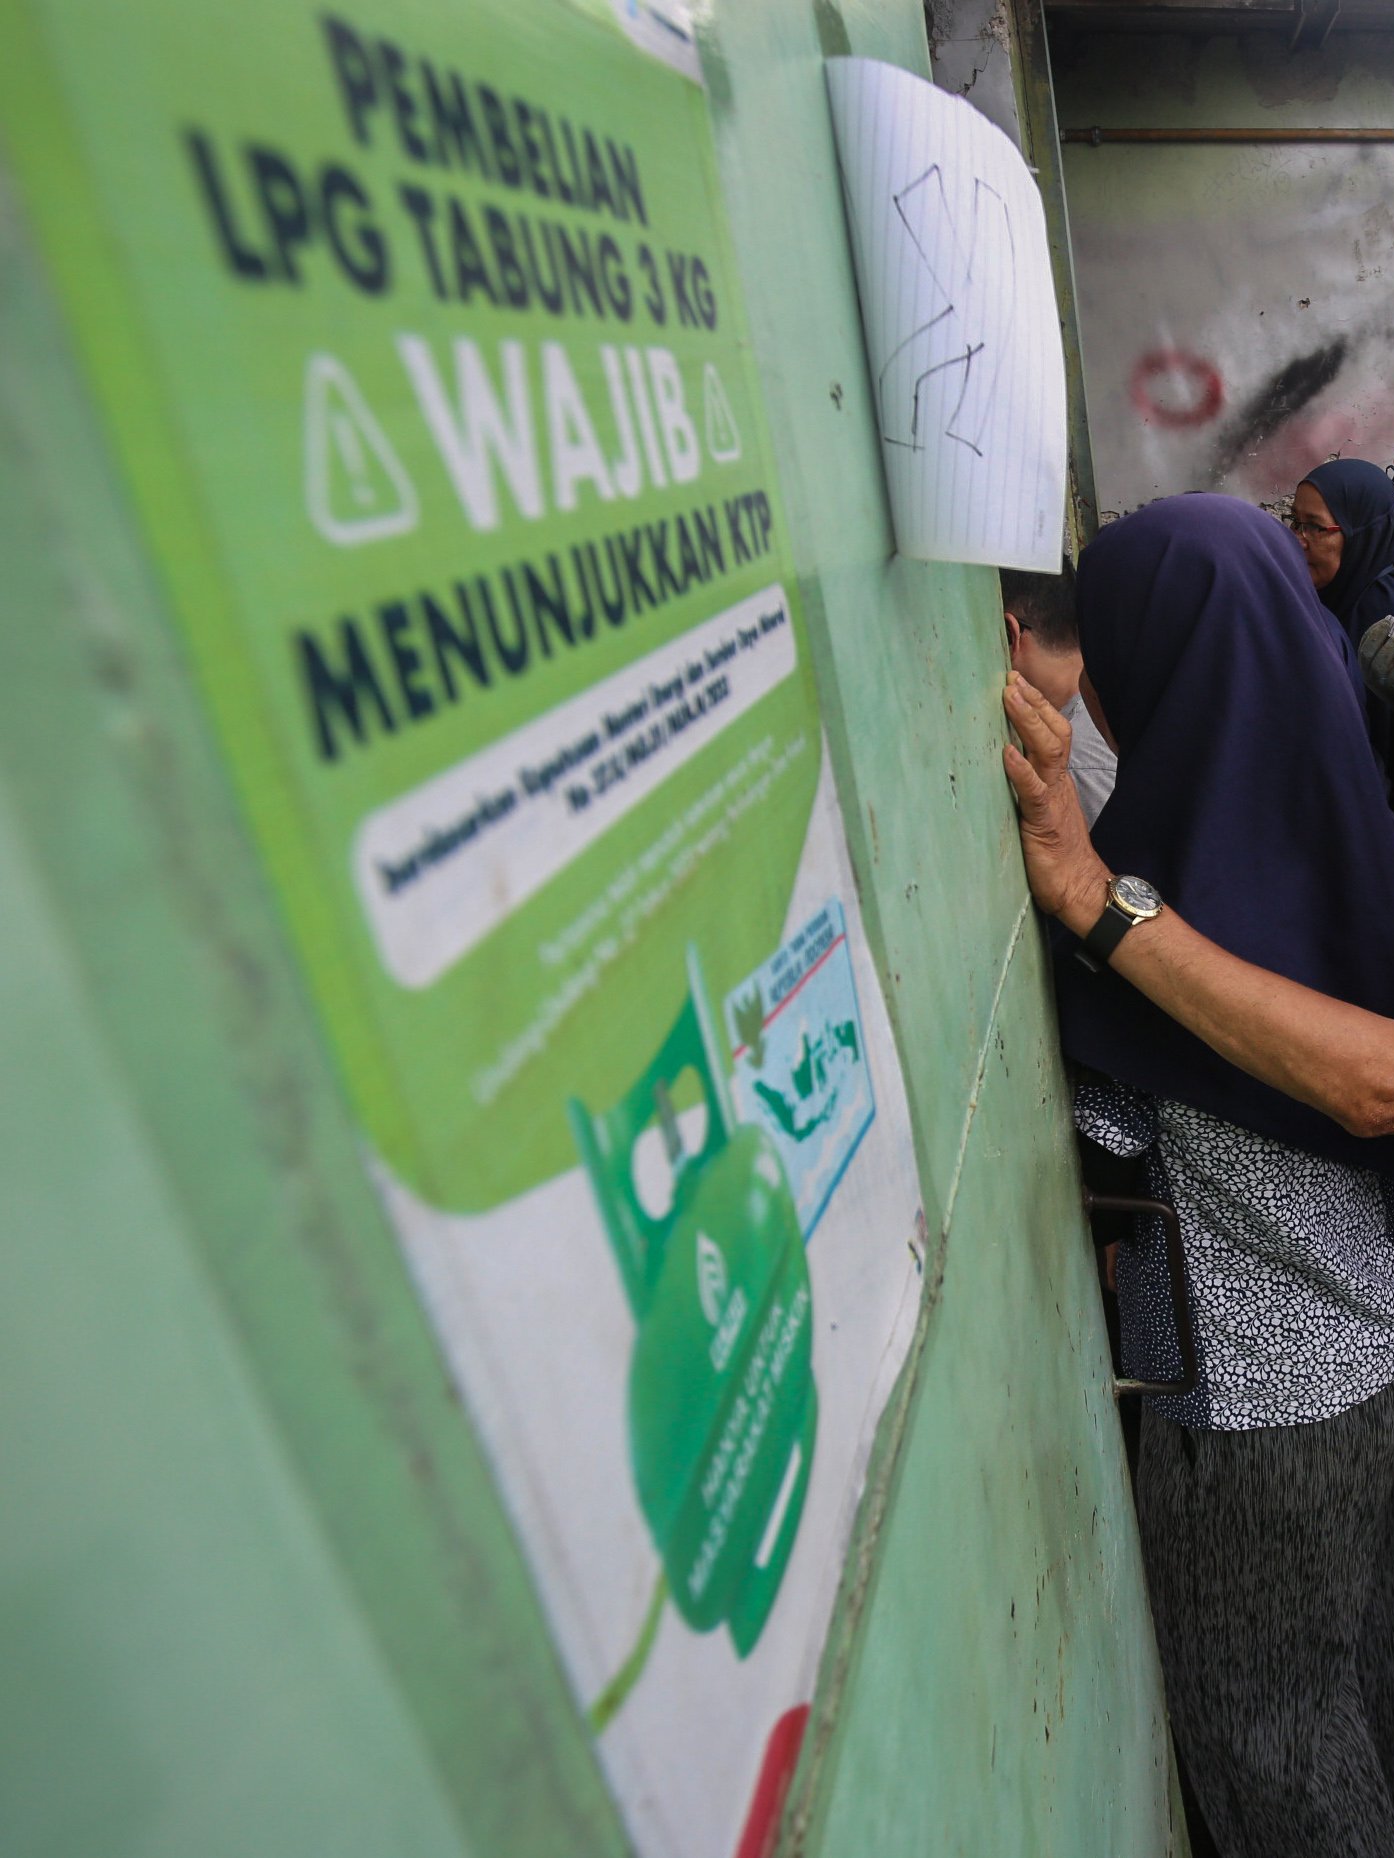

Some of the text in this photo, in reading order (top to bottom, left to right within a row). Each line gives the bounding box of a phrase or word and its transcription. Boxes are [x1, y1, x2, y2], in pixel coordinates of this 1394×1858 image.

[182, 120, 716, 331] LPG TABUNG 3 KG
[320, 13, 648, 226] PEMBELIAN
[396, 332, 700, 532] WAJIB
[292, 490, 772, 766] MENUNJUKKAN KTP
